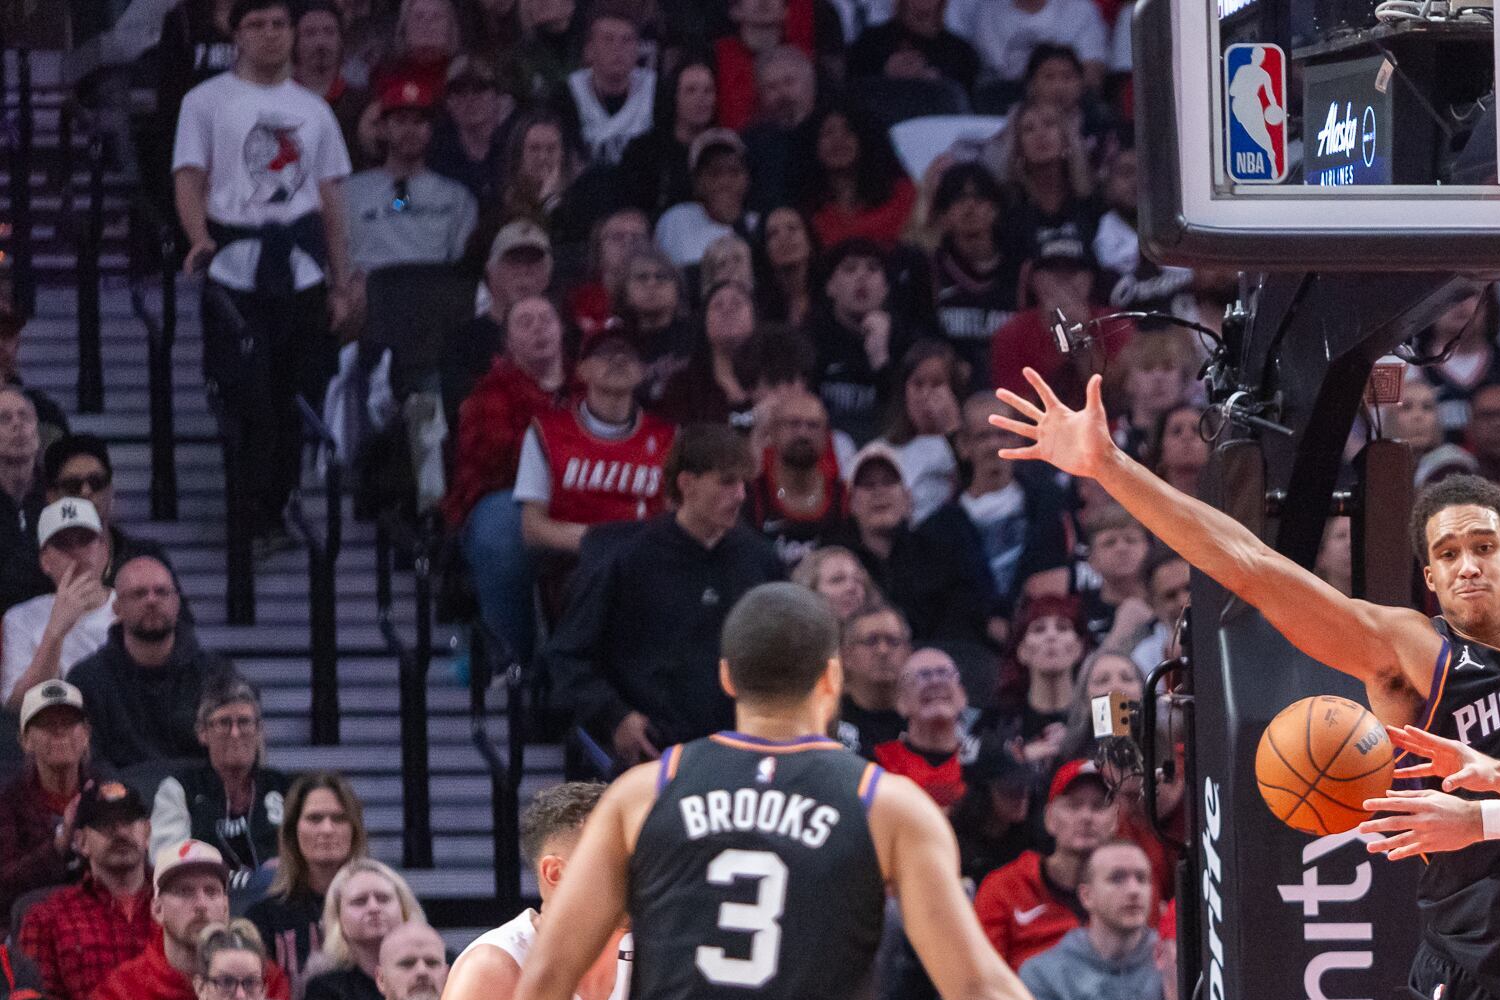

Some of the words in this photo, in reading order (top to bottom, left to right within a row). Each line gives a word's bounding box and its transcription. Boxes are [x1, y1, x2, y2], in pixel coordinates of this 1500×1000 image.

[1317, 101, 1357, 158] Alaska
[1236, 152, 1265, 174] NBA
[1320, 165, 1354, 187] AIRLINES
[680, 788, 841, 849] BROOKS
[695, 848, 789, 988] 3
